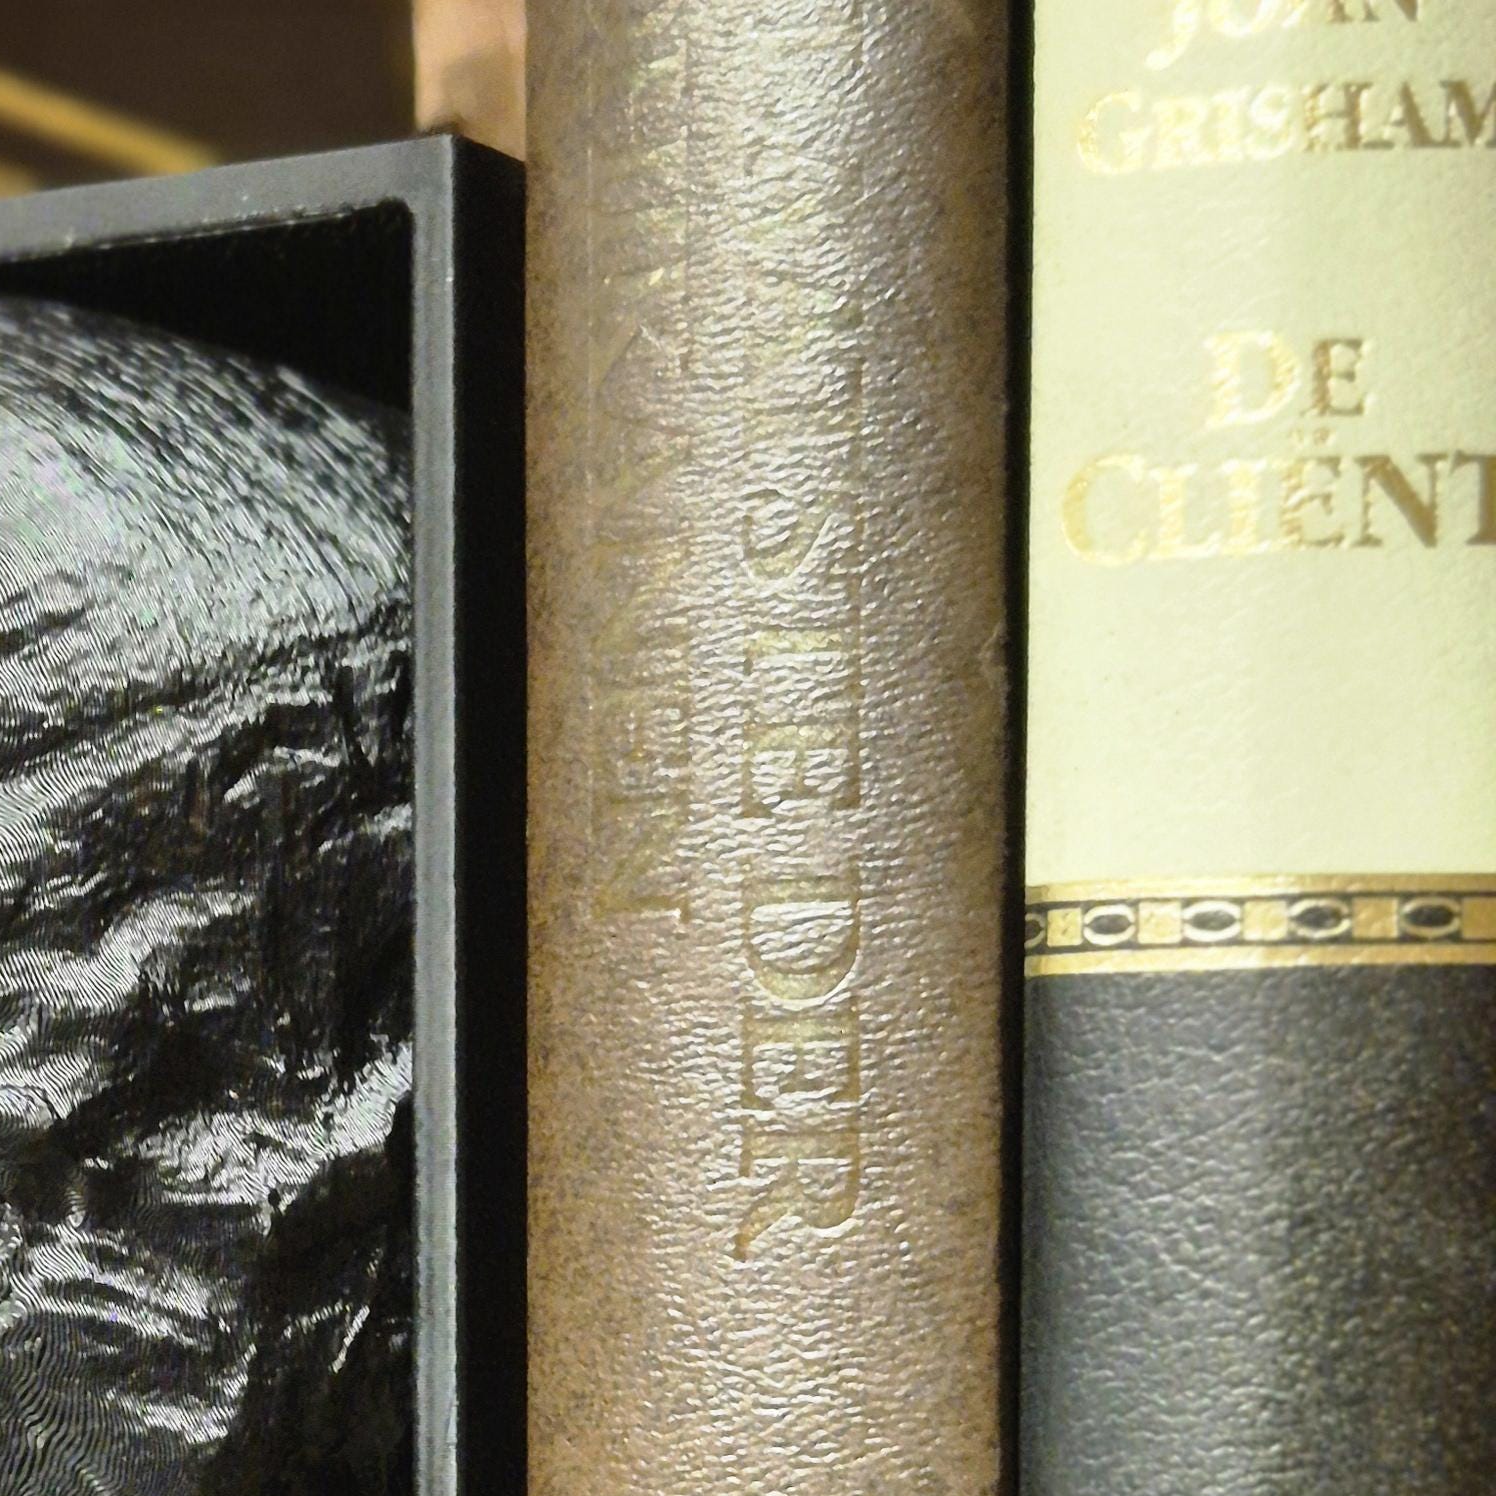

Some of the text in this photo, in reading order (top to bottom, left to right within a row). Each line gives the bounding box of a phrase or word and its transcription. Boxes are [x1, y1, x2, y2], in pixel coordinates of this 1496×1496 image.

[1203, 329, 1374, 430] DE
[1060, 449, 1496, 567] CLIENT
[734, 868, 866, 1262] DER
